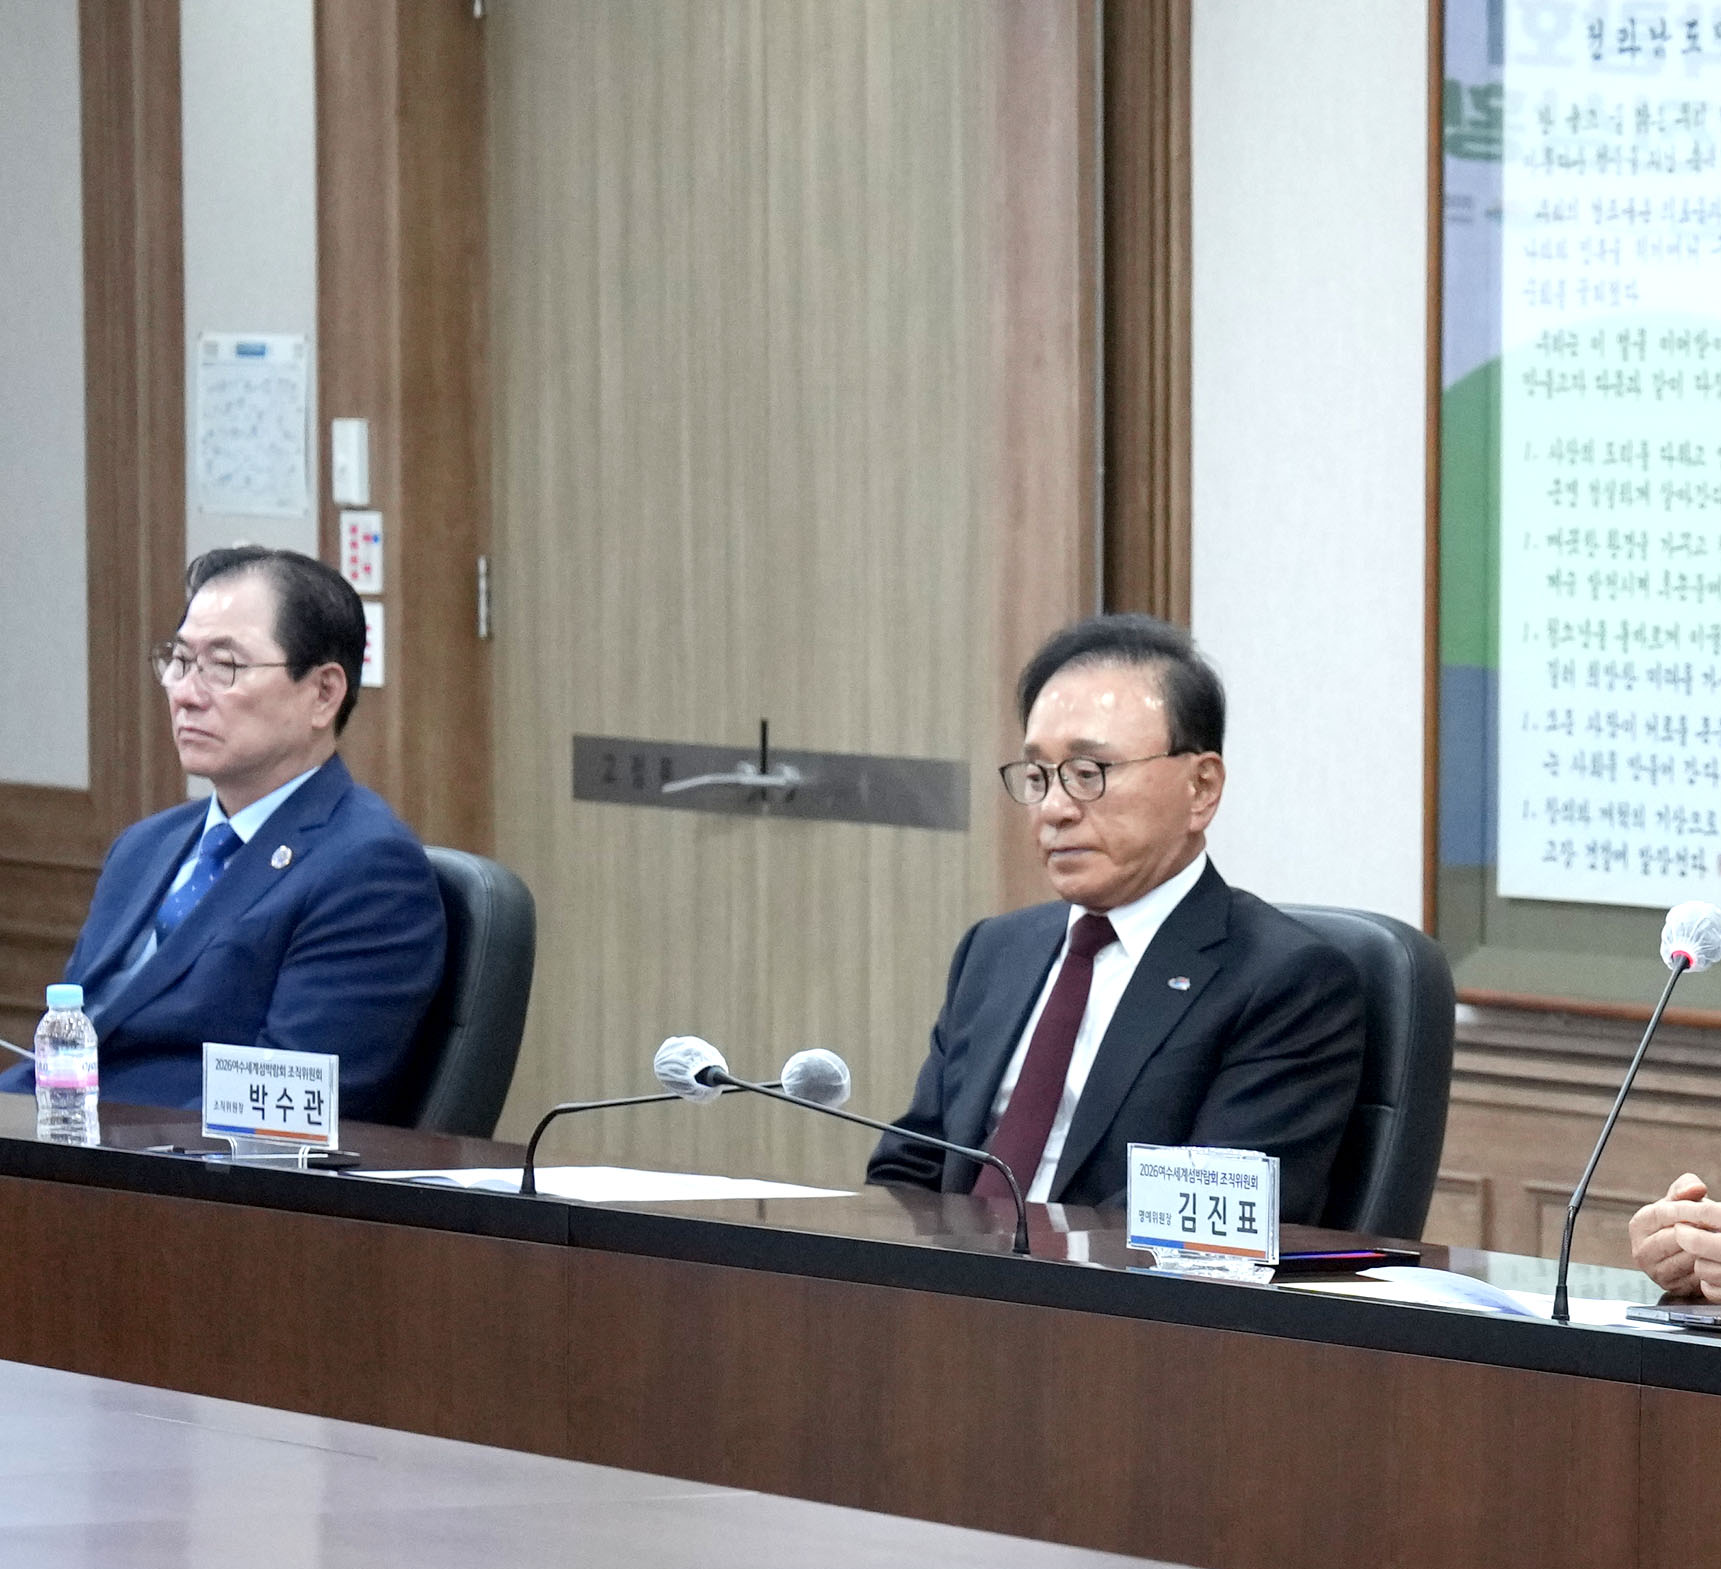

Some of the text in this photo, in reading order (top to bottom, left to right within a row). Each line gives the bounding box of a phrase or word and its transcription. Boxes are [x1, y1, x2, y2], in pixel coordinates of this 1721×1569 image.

[249, 1083, 325, 1126] 박수관
[1139, 1163, 1259, 1190] 2026여수세계섬박람회 조직위원회
[1138, 1191, 1258, 1237] 명예위원장 김진표
